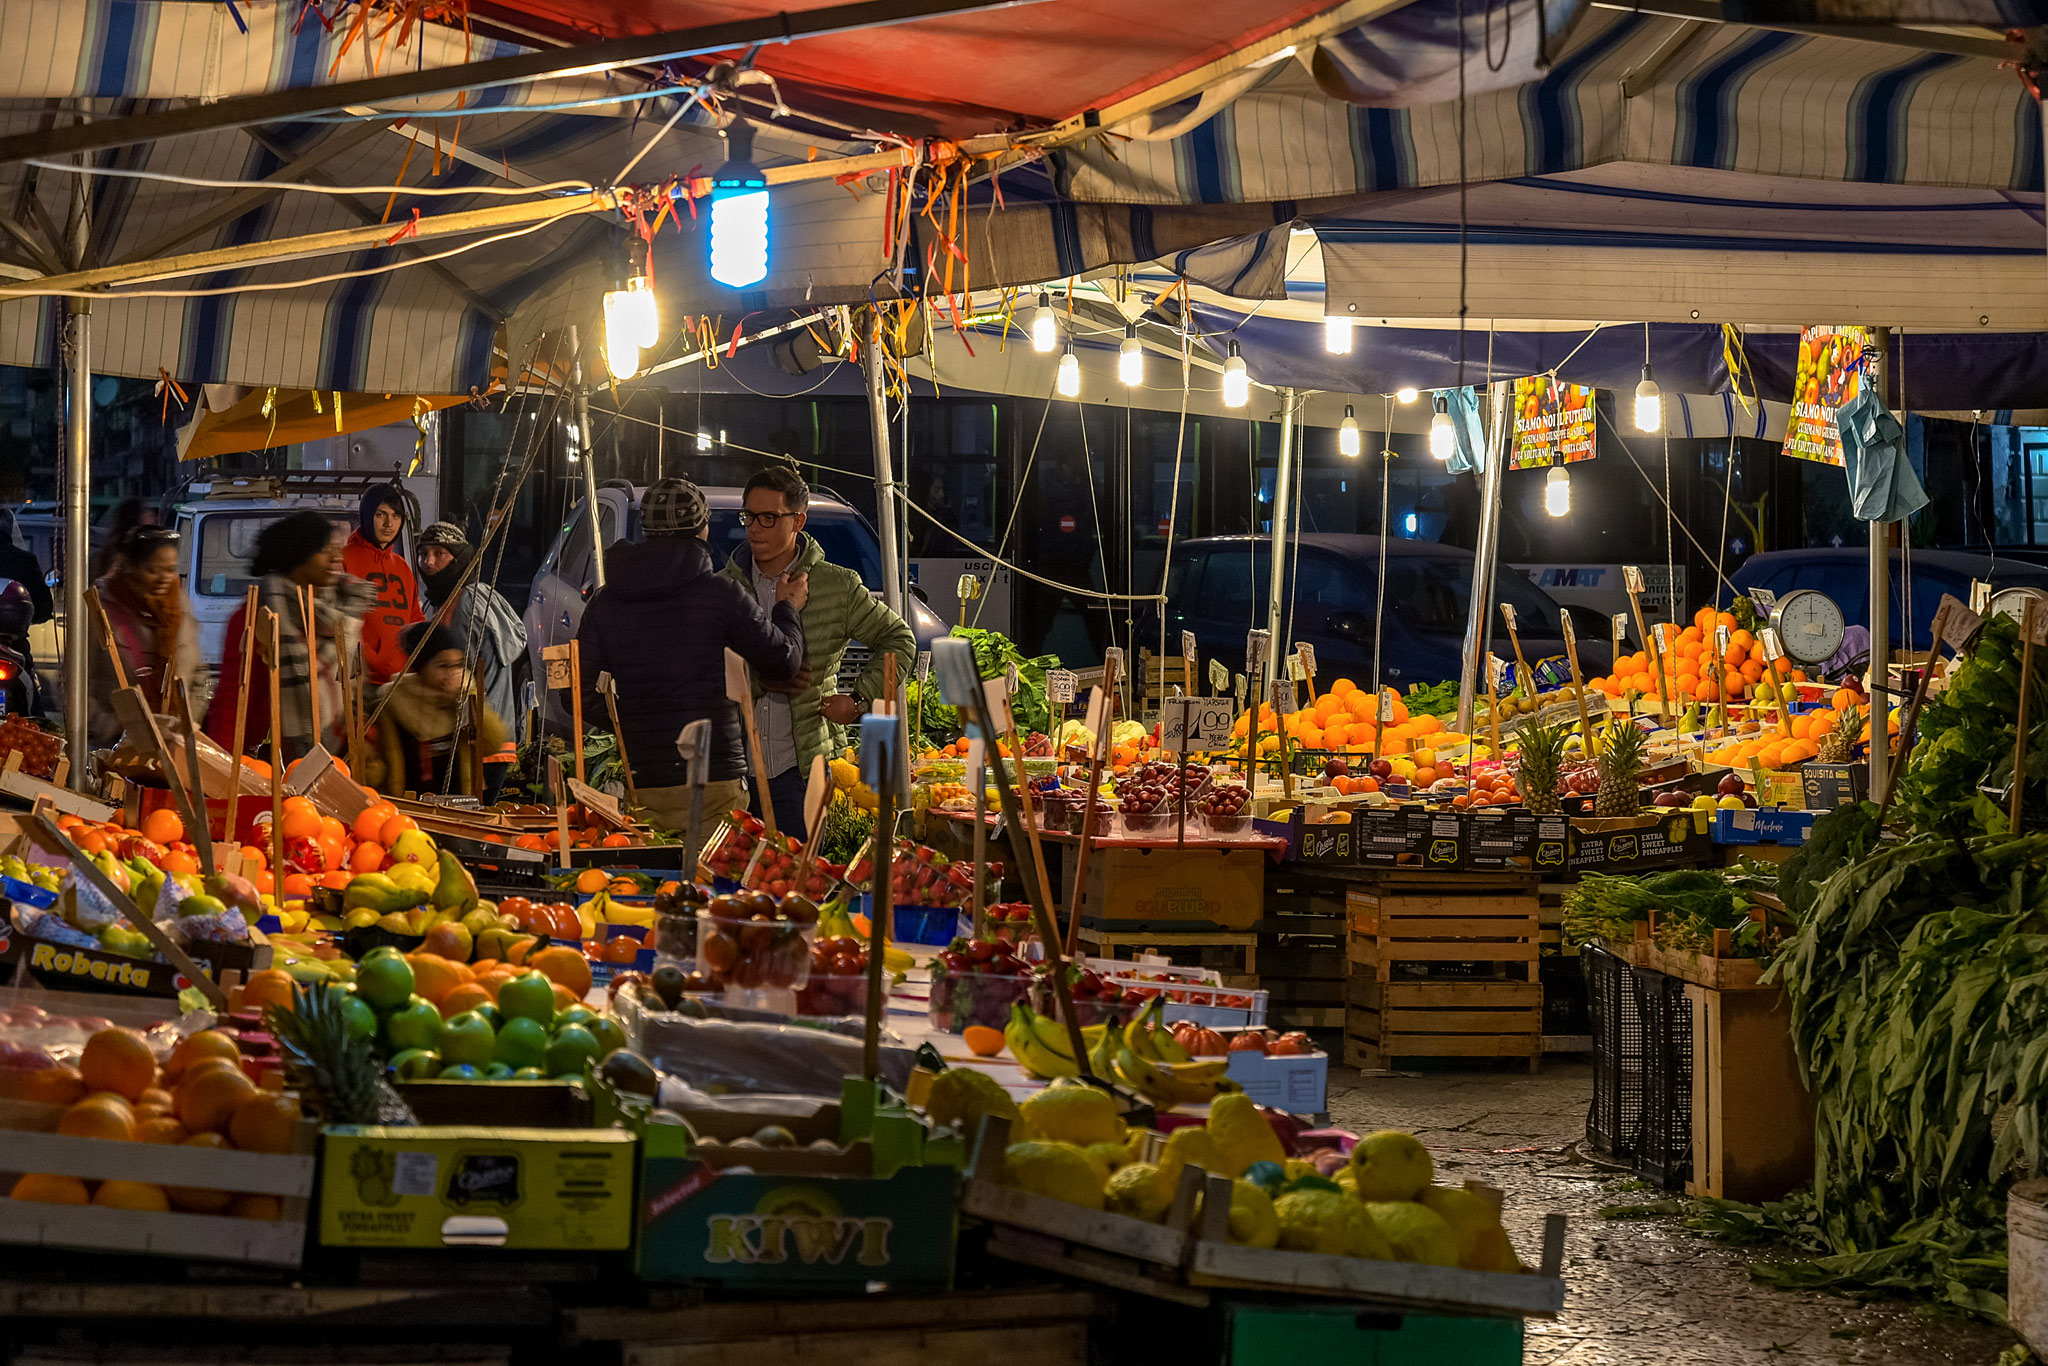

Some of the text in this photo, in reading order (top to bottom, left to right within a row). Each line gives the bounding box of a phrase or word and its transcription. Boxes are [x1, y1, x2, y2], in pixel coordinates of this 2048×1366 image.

[1795, 401, 1820, 420] SIAMO
[1820, 406, 1834, 424] NOI
[1517, 416, 1541, 433] SIAMO
[1542, 413, 1555, 428] NOI
[1565, 407, 1592, 424] FUTURO
[979, 573, 1008, 584] xit
[1538, 568, 1607, 587] AMAT
[365, 572, 408, 610] 23
[1804, 769, 1834, 779] SQUISITA
[1755, 820, 1784, 835] Marlene
[1641, 833, 1664, 841] EXTRA
[1581, 840, 1604, 849] EXTRA
[1641, 840, 1665, 849] SWEET
[1580, 848, 1604, 857] SWEET
[1642, 845, 1684, 856] PINEAPPLES
[1568, 855, 1605, 866] INEAPPLES
[31, 943, 150, 988] Roberta
[338, 1211, 415, 1221] EXTRA SWEET
[343, 1223, 410, 1232] PINEAPPLES
[704, 1213, 892, 1267] KIWI
